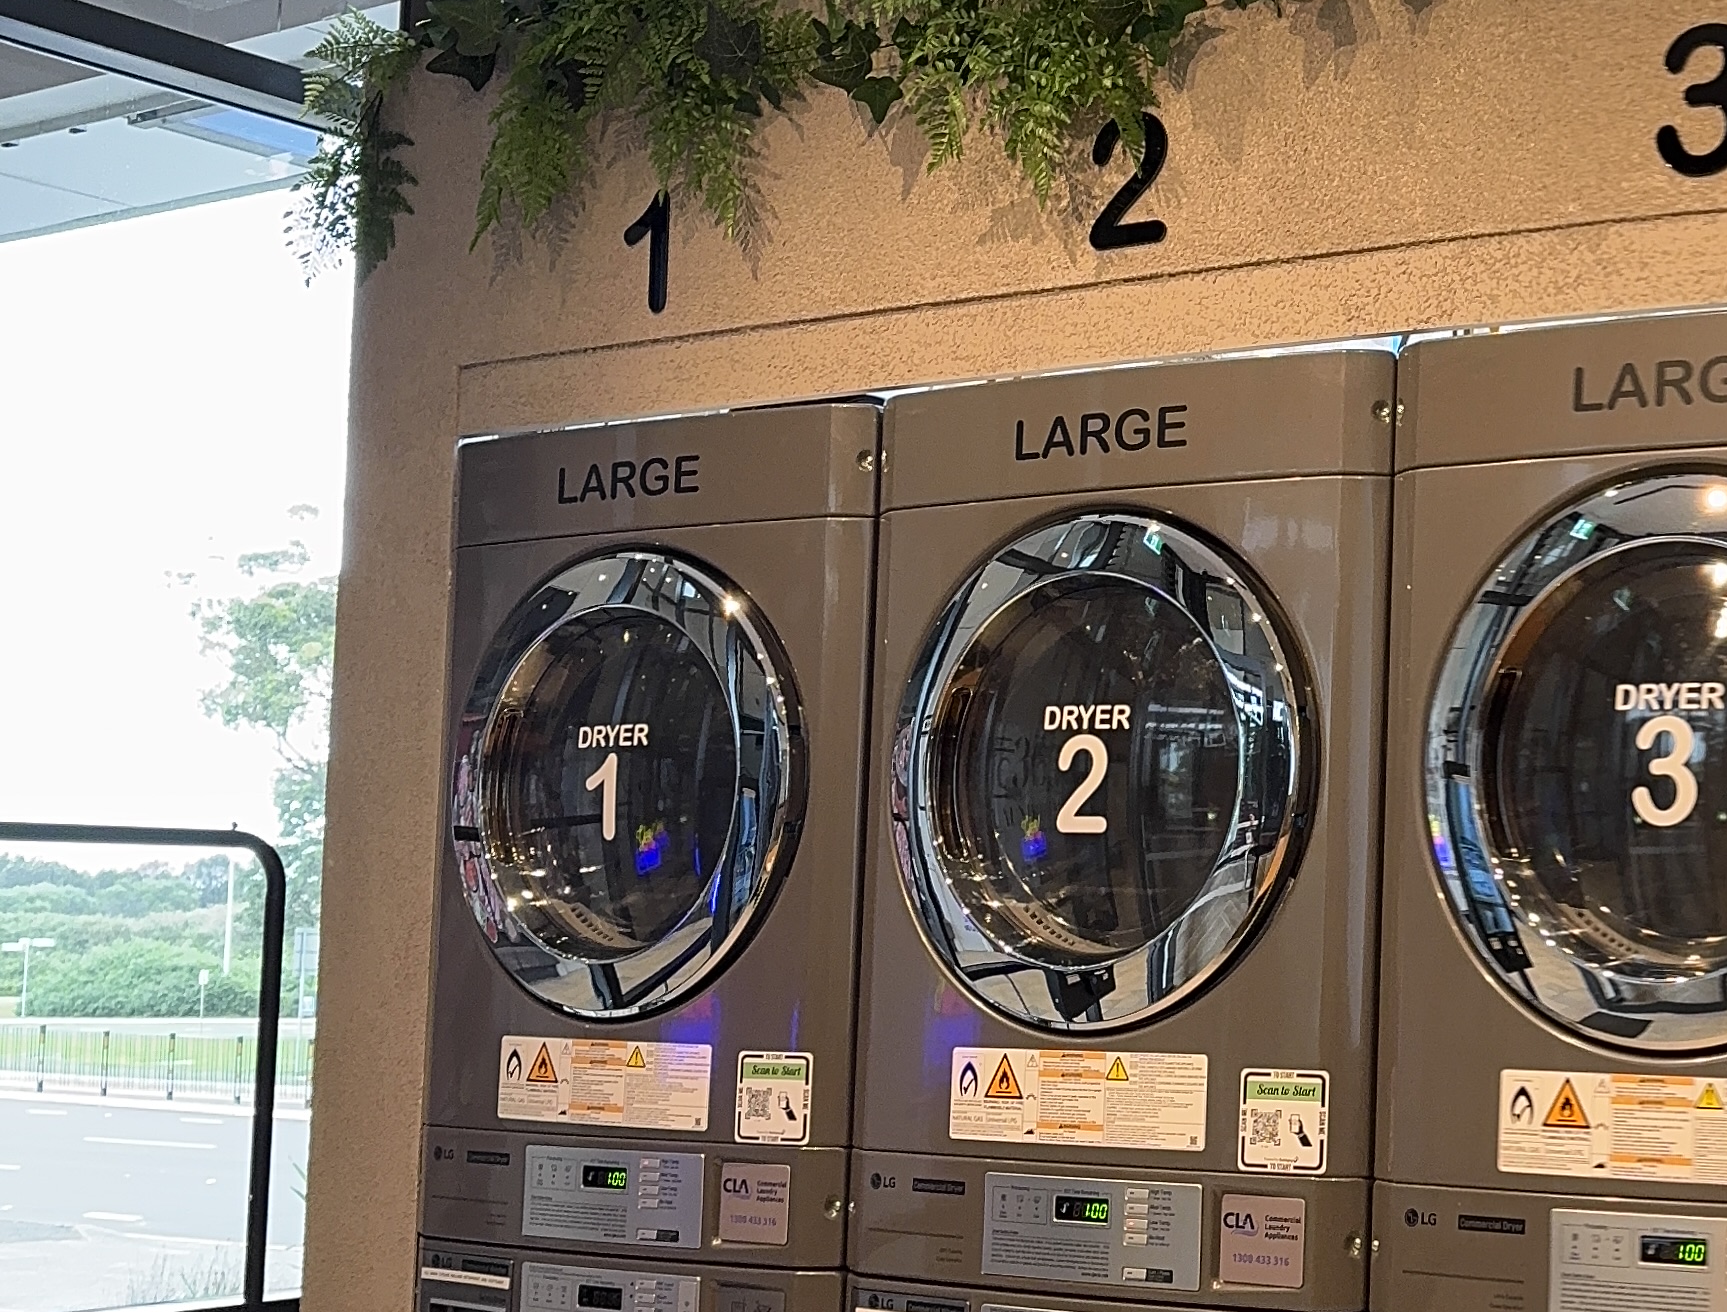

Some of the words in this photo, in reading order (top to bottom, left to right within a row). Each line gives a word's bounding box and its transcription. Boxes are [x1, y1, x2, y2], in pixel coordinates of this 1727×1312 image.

[1090, 110, 1168, 249] 2
[624, 189, 671, 313] 1
[1015, 404, 1189, 461] LARGE
[557, 455, 700, 505] LARGE
[1615, 682, 1725, 712] DRYER
[578, 723, 649, 749] DRYER
[1044, 704, 1131, 732] DRYER
[1056, 734, 1109, 834] 2
[1631, 716, 1700, 828] 3
[585, 754, 619, 841] 1
[1257, 1083, 1279, 1095] Scan
[1281, 1086, 1290, 1096] to
[1293, 1085, 1316, 1097] Start
[723, 1178, 748, 1193] CLA
[1223, 1212, 1254, 1230] CLA
[1421, 1212, 1437, 1226] LG
